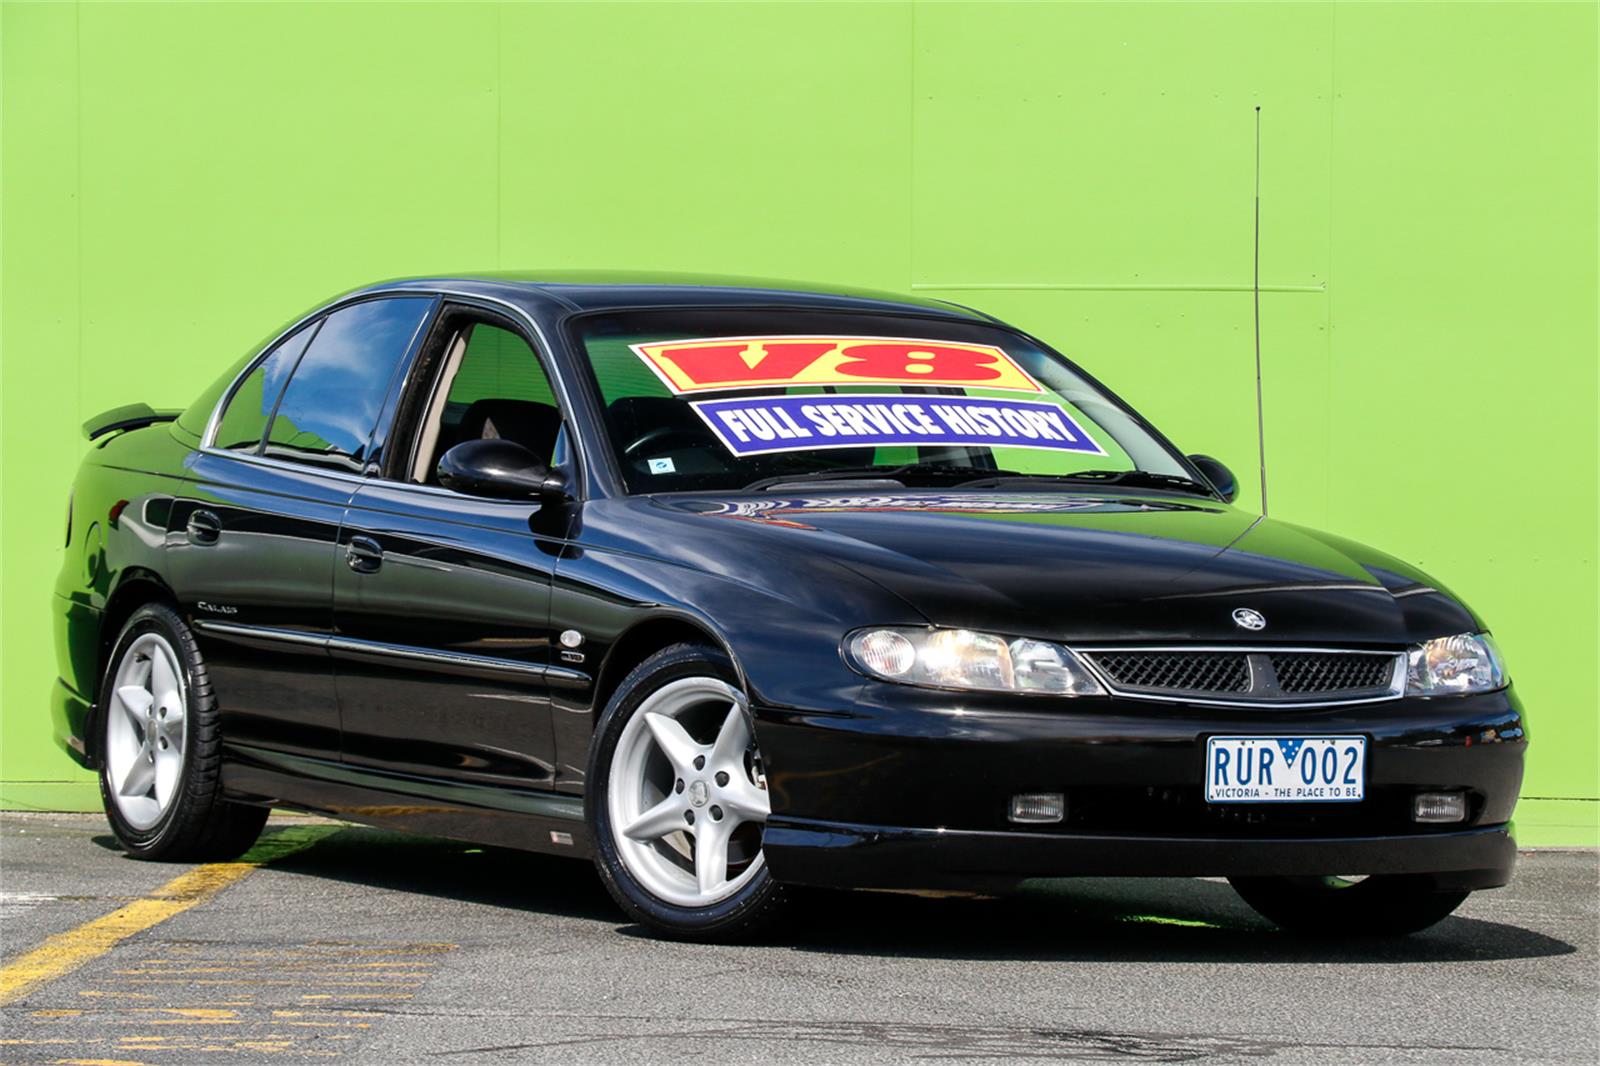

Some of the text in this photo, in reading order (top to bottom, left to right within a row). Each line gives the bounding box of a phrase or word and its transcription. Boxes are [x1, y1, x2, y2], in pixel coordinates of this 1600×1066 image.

[660, 344, 1003, 384] V8
[716, 404, 1078, 442] FULL SERVICE HISTORY
[1214, 746, 1358, 785] RUR 002
[1215, 788, 1260, 798] VICTORIA
[1274, 788, 1292, 798] THE
[1296, 787, 1325, 797] PLACE
[1329, 787, 1341, 797] TO
[1345, 787, 1356, 796] BE
